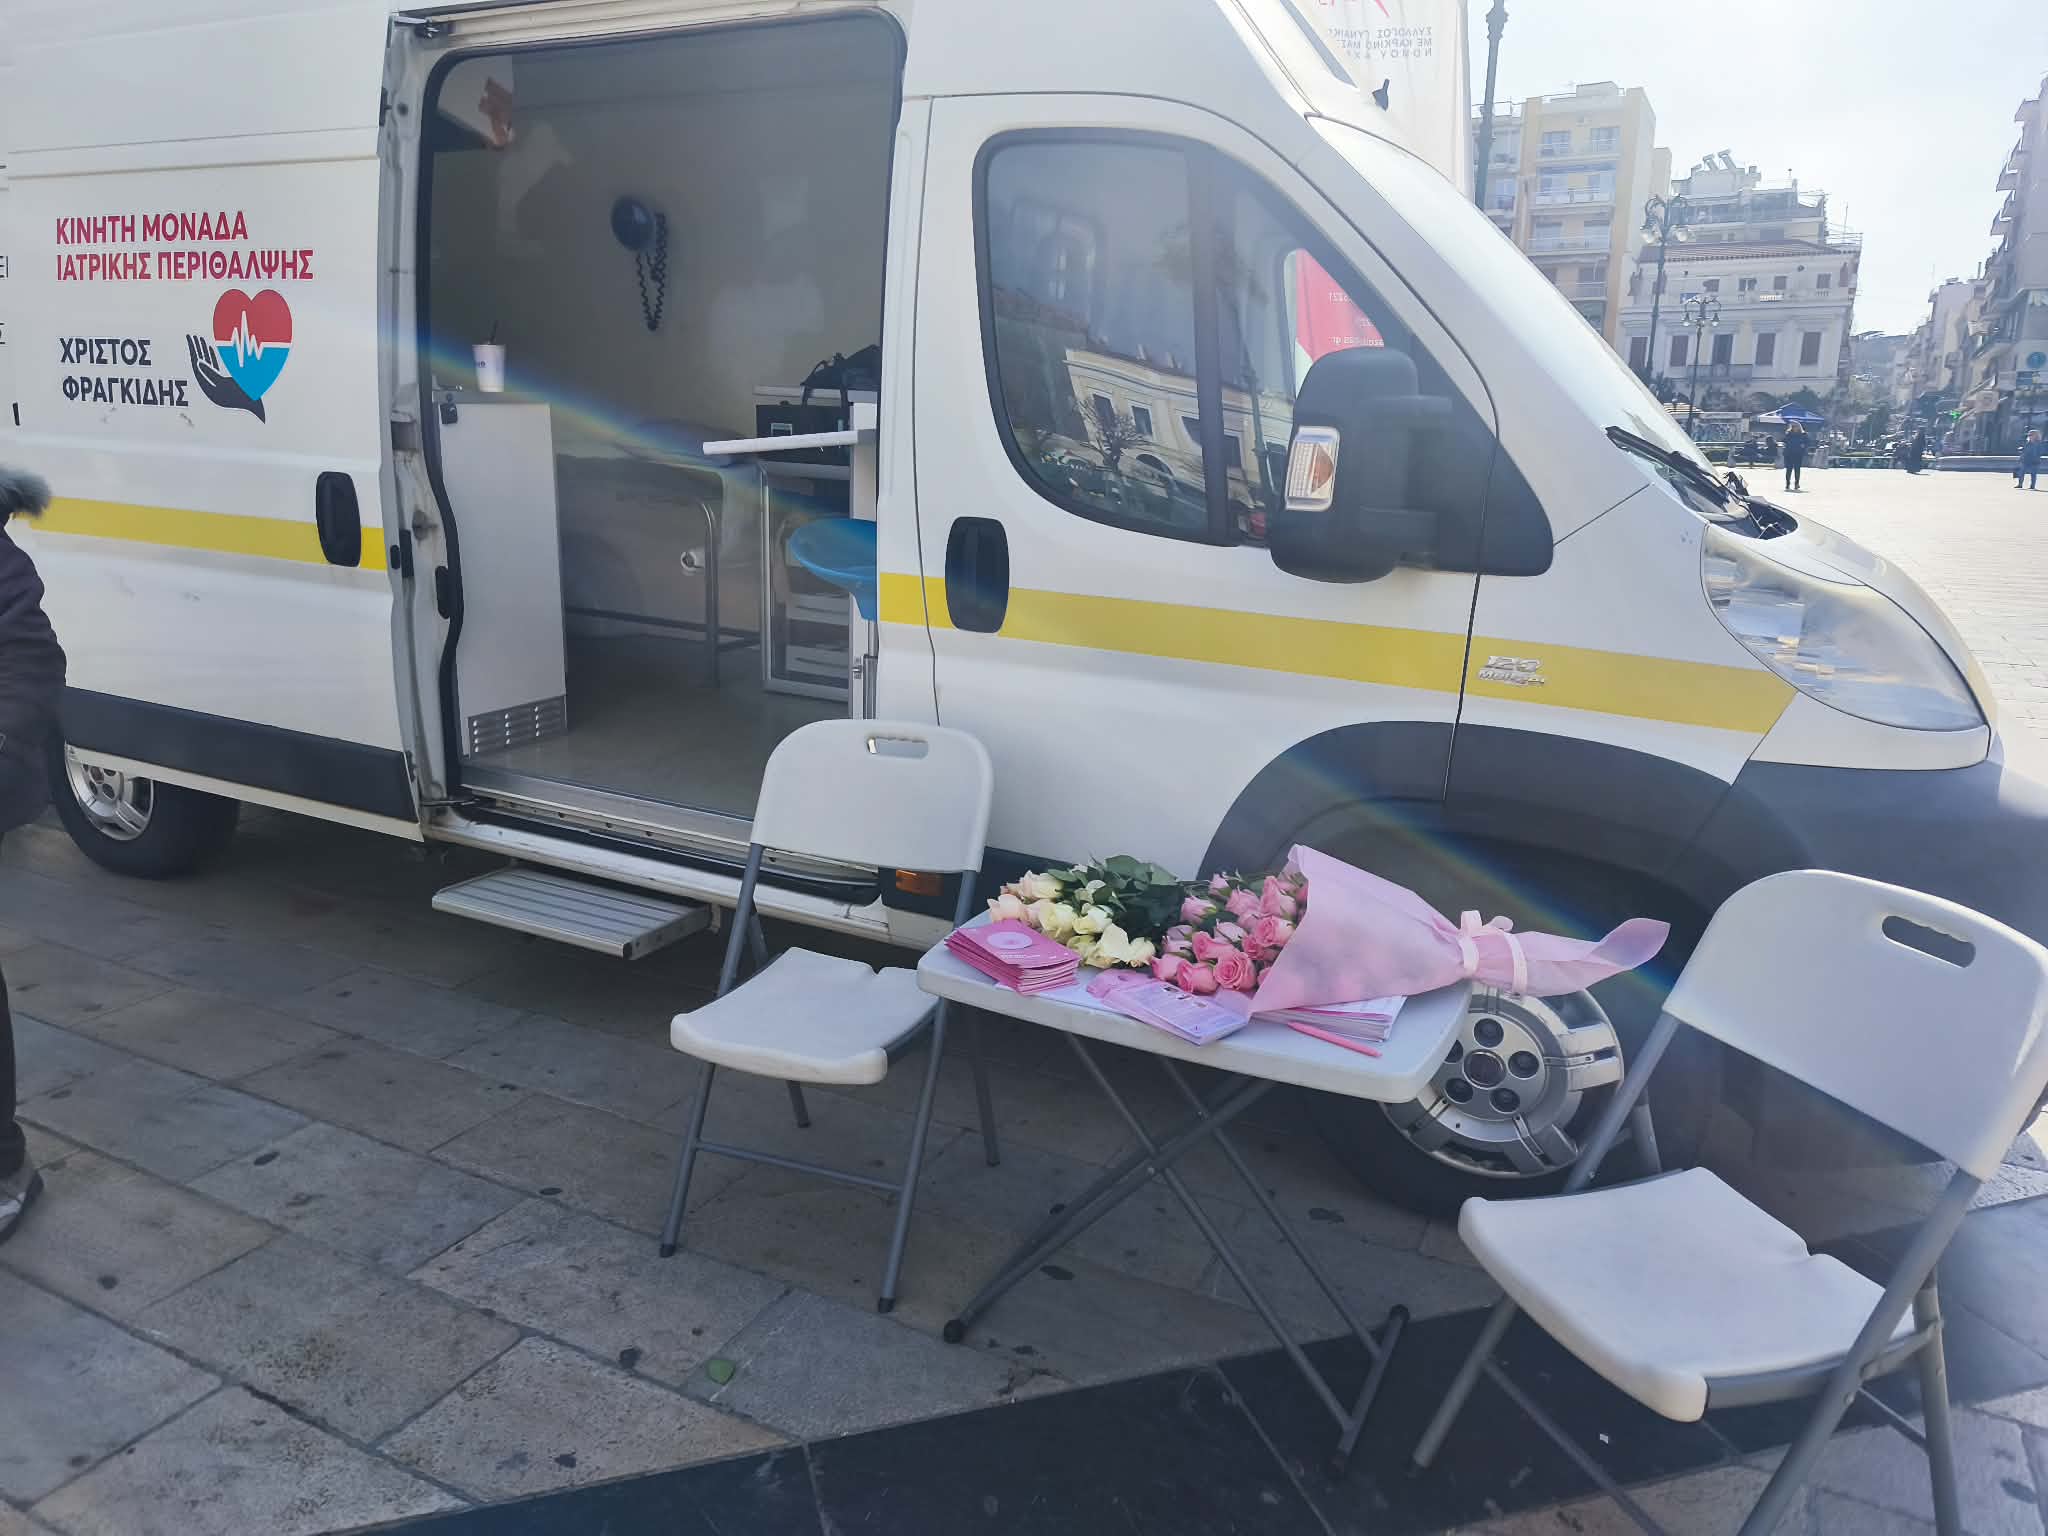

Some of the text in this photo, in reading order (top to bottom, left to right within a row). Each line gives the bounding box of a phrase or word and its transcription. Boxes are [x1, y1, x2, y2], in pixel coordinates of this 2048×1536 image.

[56, 210, 248, 245] ΚΙΝΗΤΗ ΜΟΝΑΔΑ
[57, 249, 313, 281] ΙΑΤΡΙΚΗΣ ΠΕΡΙΘΑΛΨΗΣ
[60, 338, 151, 366] ΧΡΙΣΤΟΣ
[62, 375, 189, 407] ΦΡΑΓΚΙΔΗΣ
